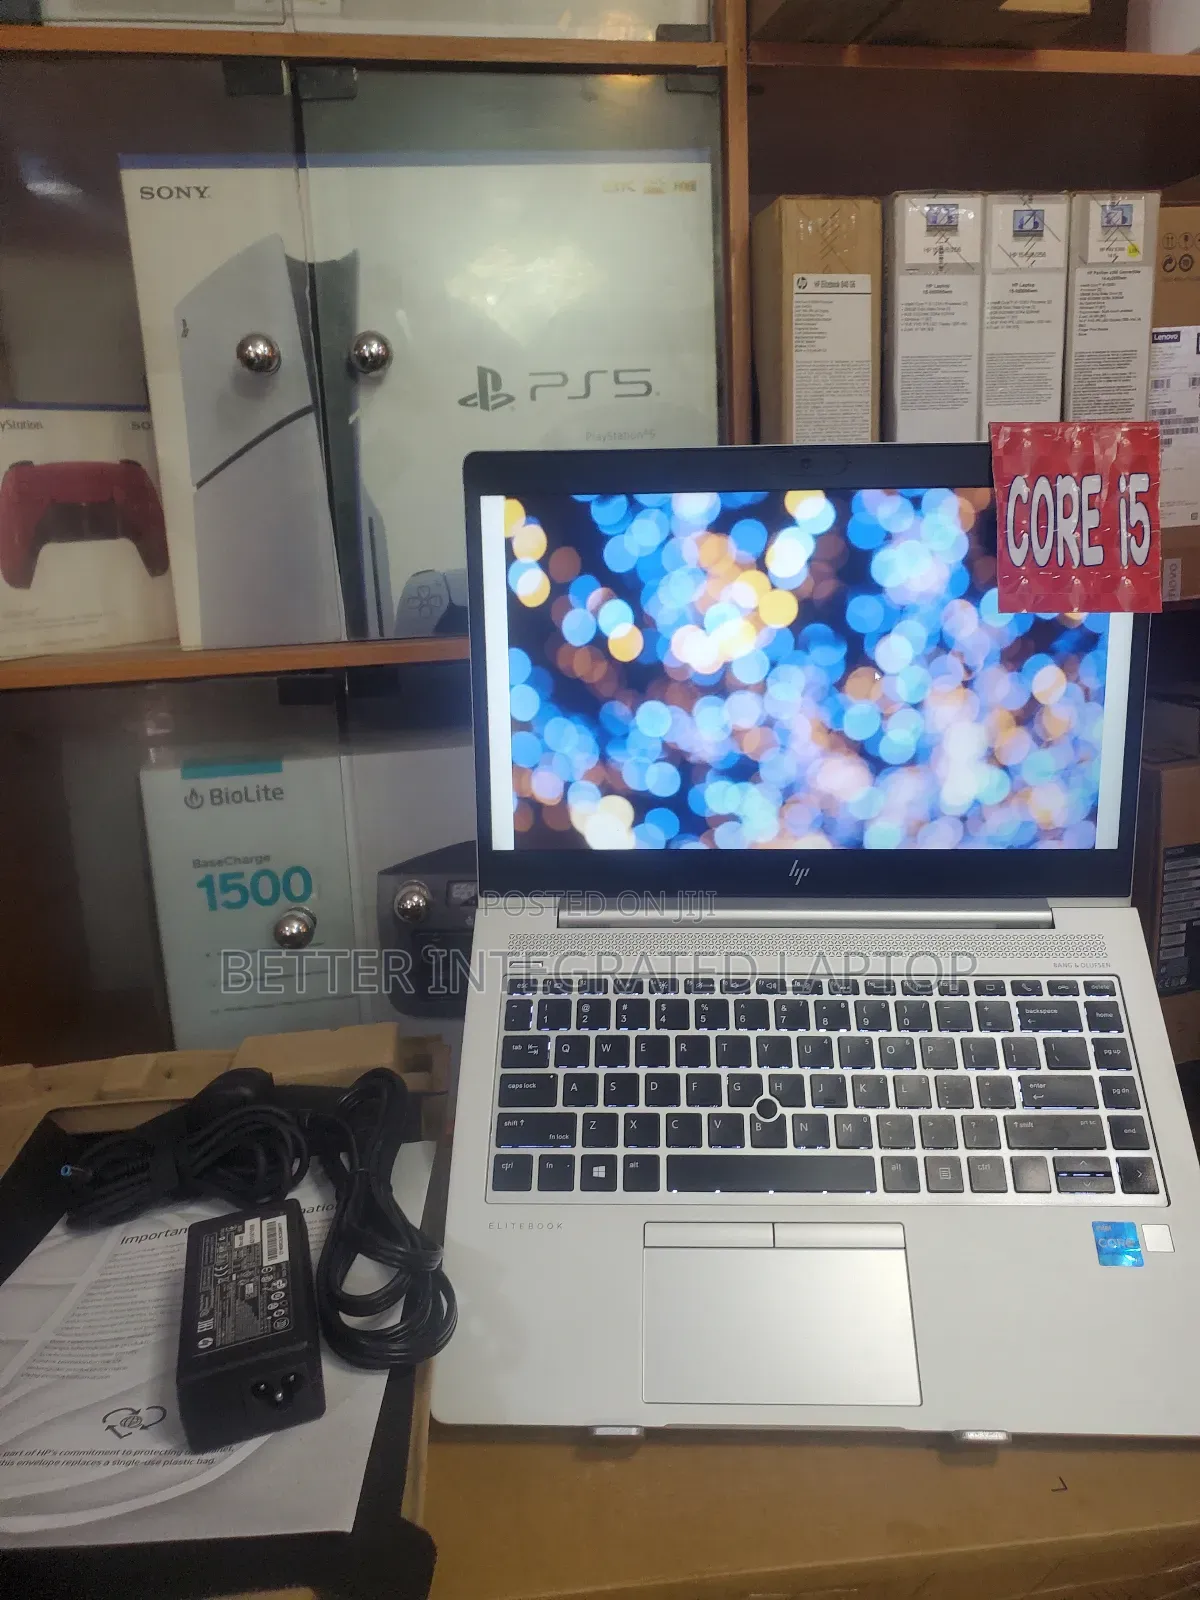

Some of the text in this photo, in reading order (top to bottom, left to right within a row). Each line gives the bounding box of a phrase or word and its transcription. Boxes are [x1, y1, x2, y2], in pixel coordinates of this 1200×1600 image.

[139, 185, 209, 200] SONY
[1153, 333, 1179, 341] Lenovo
[528, 368, 655, 401] PS5
[131, 422, 153, 431] SO
[1006, 472, 1151, 568] CORE i5
[209, 784, 284, 807] BioLite
[192, 854, 271, 869] BaseCharge
[196, 865, 313, 912] 1500
[582, 1015, 588, 1023] 2
[621, 1015, 627, 1023] 3
[660, 1015, 667, 1023] 4
[700, 1015, 706, 1023] 5
[740, 1015, 746, 1023] 6
[903, 1018, 910, 1026] 0
[561, 1043, 571, 1053] Q
[601, 1043, 612, 1052] W
[640, 1043, 646, 1052] E
[680, 1043, 687, 1052] R
[721, 1043, 728, 1052] T
[762, 1043, 769, 1052] Y
[804, 1045, 812, 1053] U
[886, 1045, 895, 1054] O
[927, 1045, 934, 1054] P
[570, 1082, 578, 1091] A
[610, 1082, 617, 1091] S
[650, 1082, 658, 1091] D
[692, 1082, 698, 1091] F
[733, 1082, 741, 1091] G
[775, 1082, 783, 1091] H
[859, 1083, 867, 1093] K
[901, 1085, 908, 1093] L
[504, 1119, 518, 1127] shift
[589, 1120, 597, 1130] Z
[629, 1120, 637, 1129] X
[671, 1119, 679, 1129] C
[713, 1120, 722, 1129] V
[755, 1123, 762, 1131] B
[800, 1122, 808, 1131] N
[842, 1123, 853, 1132] M
[501, 1161, 514, 1170] ctrl
[545, 1161, 553, 1169] fn
[891, 1163, 902, 1171] alt
[488, 1222, 563, 1230] ELITEBOOK
[120, 1226, 188, 1245] Importan
[2, 1449, 23, 1457] part
[37, 1448, 57, 1456] HP's
[59, 1448, 120, 1457] commitment
[133, 1448, 183, 1457] protecting
[16, 1459, 60, 1467] envelope
[61, 1459, 101, 1467] replaces
[112, 1459, 161, 1467] single-use
[162, 1458, 194, 1467] plastic
